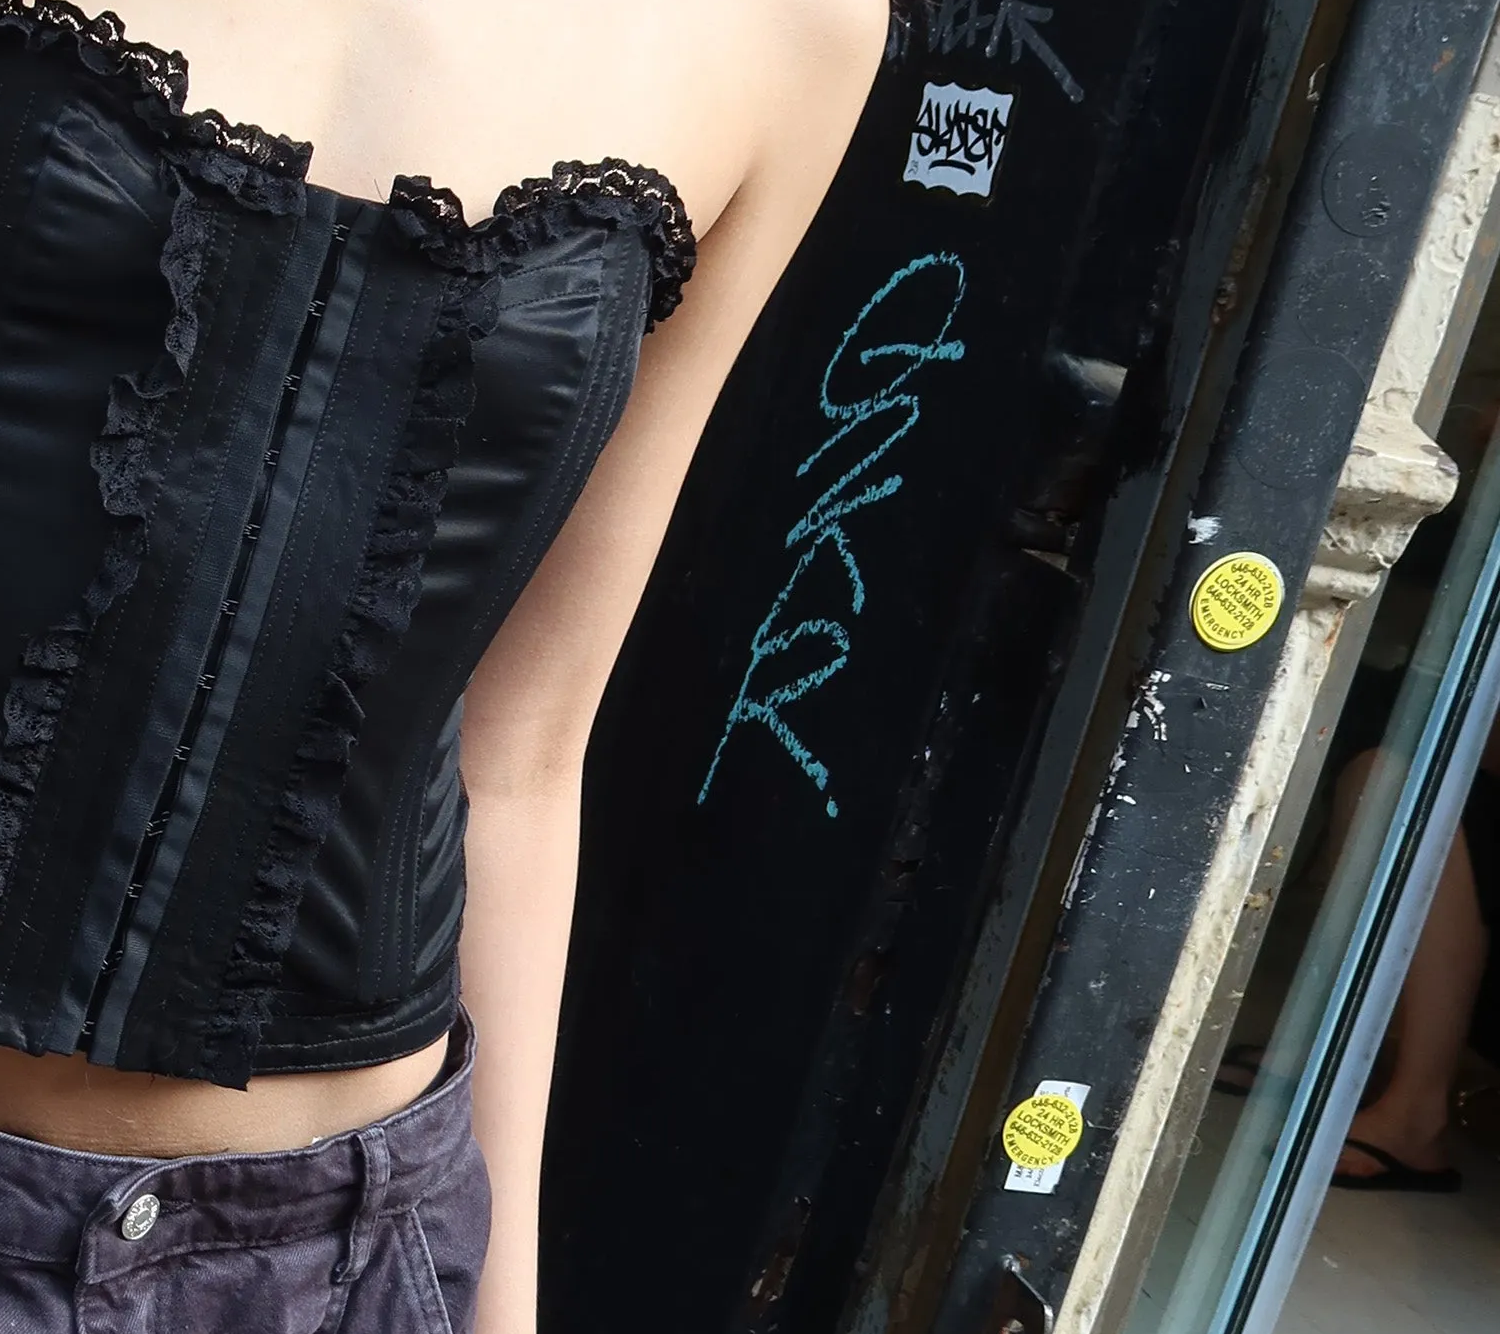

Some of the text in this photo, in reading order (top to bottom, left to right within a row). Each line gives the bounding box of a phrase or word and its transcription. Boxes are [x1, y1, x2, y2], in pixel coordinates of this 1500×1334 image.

[1214, 573, 1265, 621] LOCKSMITH
[1231, 563, 1274, 609] 646-632-2128
[1234, 574, 1262, 602] 24 HR
[1200, 597, 1245, 639] EMERGENCY
[1206, 584, 1256, 631] 646-632-2128
[1016, 1109, 1071, 1146] LOCKSMITH
[1036, 1108, 1066, 1130] 24 HR
[1005, 1133, 1054, 1166] EMERGENCY
[1009, 1120, 1063, 1156] 646-632-2128
